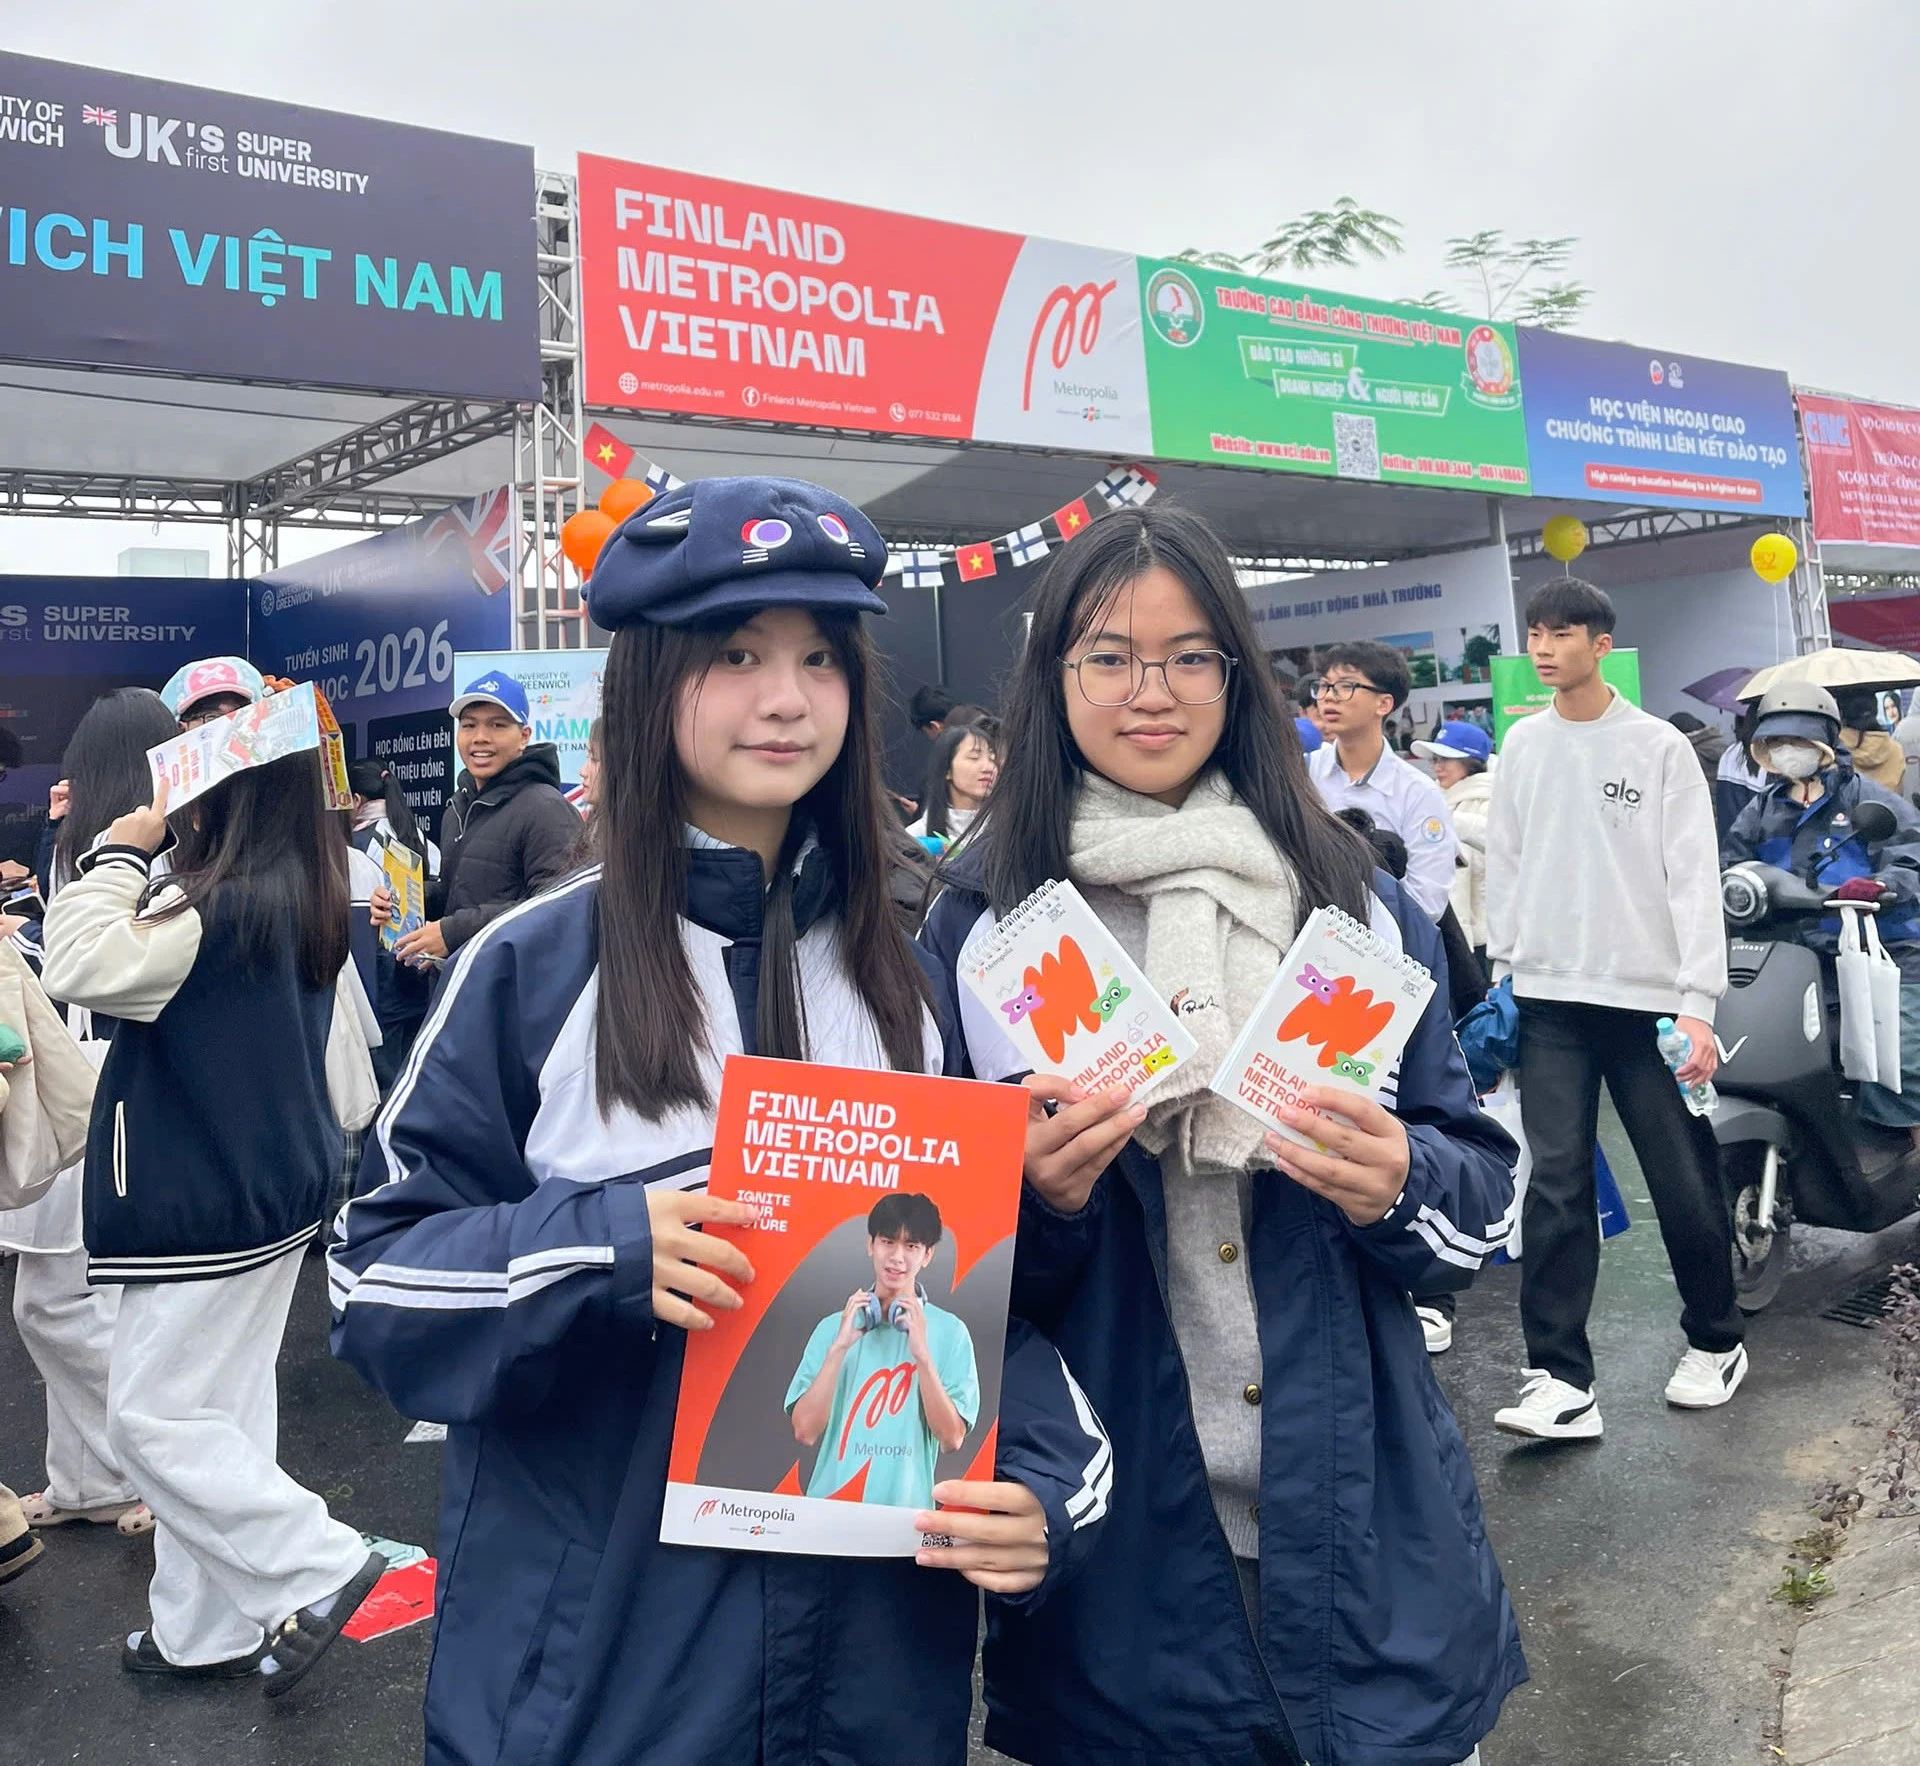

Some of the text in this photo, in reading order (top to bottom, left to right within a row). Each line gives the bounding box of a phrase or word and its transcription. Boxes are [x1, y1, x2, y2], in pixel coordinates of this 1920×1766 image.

[36, 101, 64, 122] OF
[185, 147, 229, 173] first
[236, 131, 312, 163] SUPER
[236, 160, 369, 194] UNIVERSITY
[614, 187, 846, 265] FINLAND
[0, 206, 503, 321] ICH VIỆT NAM
[617, 246, 946, 334] METROPOLIA
[1268, 295, 1294, 319] CAO
[1330, 304, 1363, 331] CÔNG
[1410, 319, 1434, 346] VIỆT
[1435, 325, 1462, 348] NAM
[618, 305, 867, 377] VIETNAM
[641, 381, 726, 398] metropolia.edu.vn
[1054, 381, 1118, 400] Metropolia
[1347, 367, 1372, 402] &
[763, 392, 877, 414] Finland Metropolia Vietnam
[1590, 396, 1745, 435] HỌC VIỆN NGOẠI GIAO
[1546, 418, 1787, 470] CHƯƠNG TRÌNH LIÊN KẾT ĐÀO TẠO
[1363, 589, 1388, 607] NHÀ
[1391, 583, 1442, 603] TRƯỜNG
[43, 606, 130, 623] SUPER
[43, 625, 197, 641] UNIVERSITY
[285, 642, 349, 673] TUYỂN SINH
[355, 619, 453, 697] 2026
[514, 671, 569, 681] UNIVERSITY OF
[520, 680, 570, 689] REENWICH
[376, 739, 391, 758] HỌC
[416, 731, 432, 750] LÊN
[434, 726, 451, 748] ĐẾN
[535, 712, 590, 741] NĂM
[396, 761, 419, 782] TRIỆU
[403, 787, 441, 807] INH VIÊN
[1603, 777, 1640, 803] alo
[985, 947, 1013, 971] Metropolia
[1072, 1041, 1127, 1088] INLAND
[1085, 1032, 1167, 1099] ETROPOLIA
[1252, 1052, 1308, 1092] FINLAN
[748, 1090, 897, 1129] FINLAND
[1238, 1081, 1282, 1119] VIETN
[744, 1119, 961, 1166] METROPOLIA
[742, 1148, 900, 1189] VIETNAM
[736, 1189, 791, 1207] IGNITE
[742, 1219, 788, 1232] TURE
[720, 1503, 795, 1522] Metropolia
